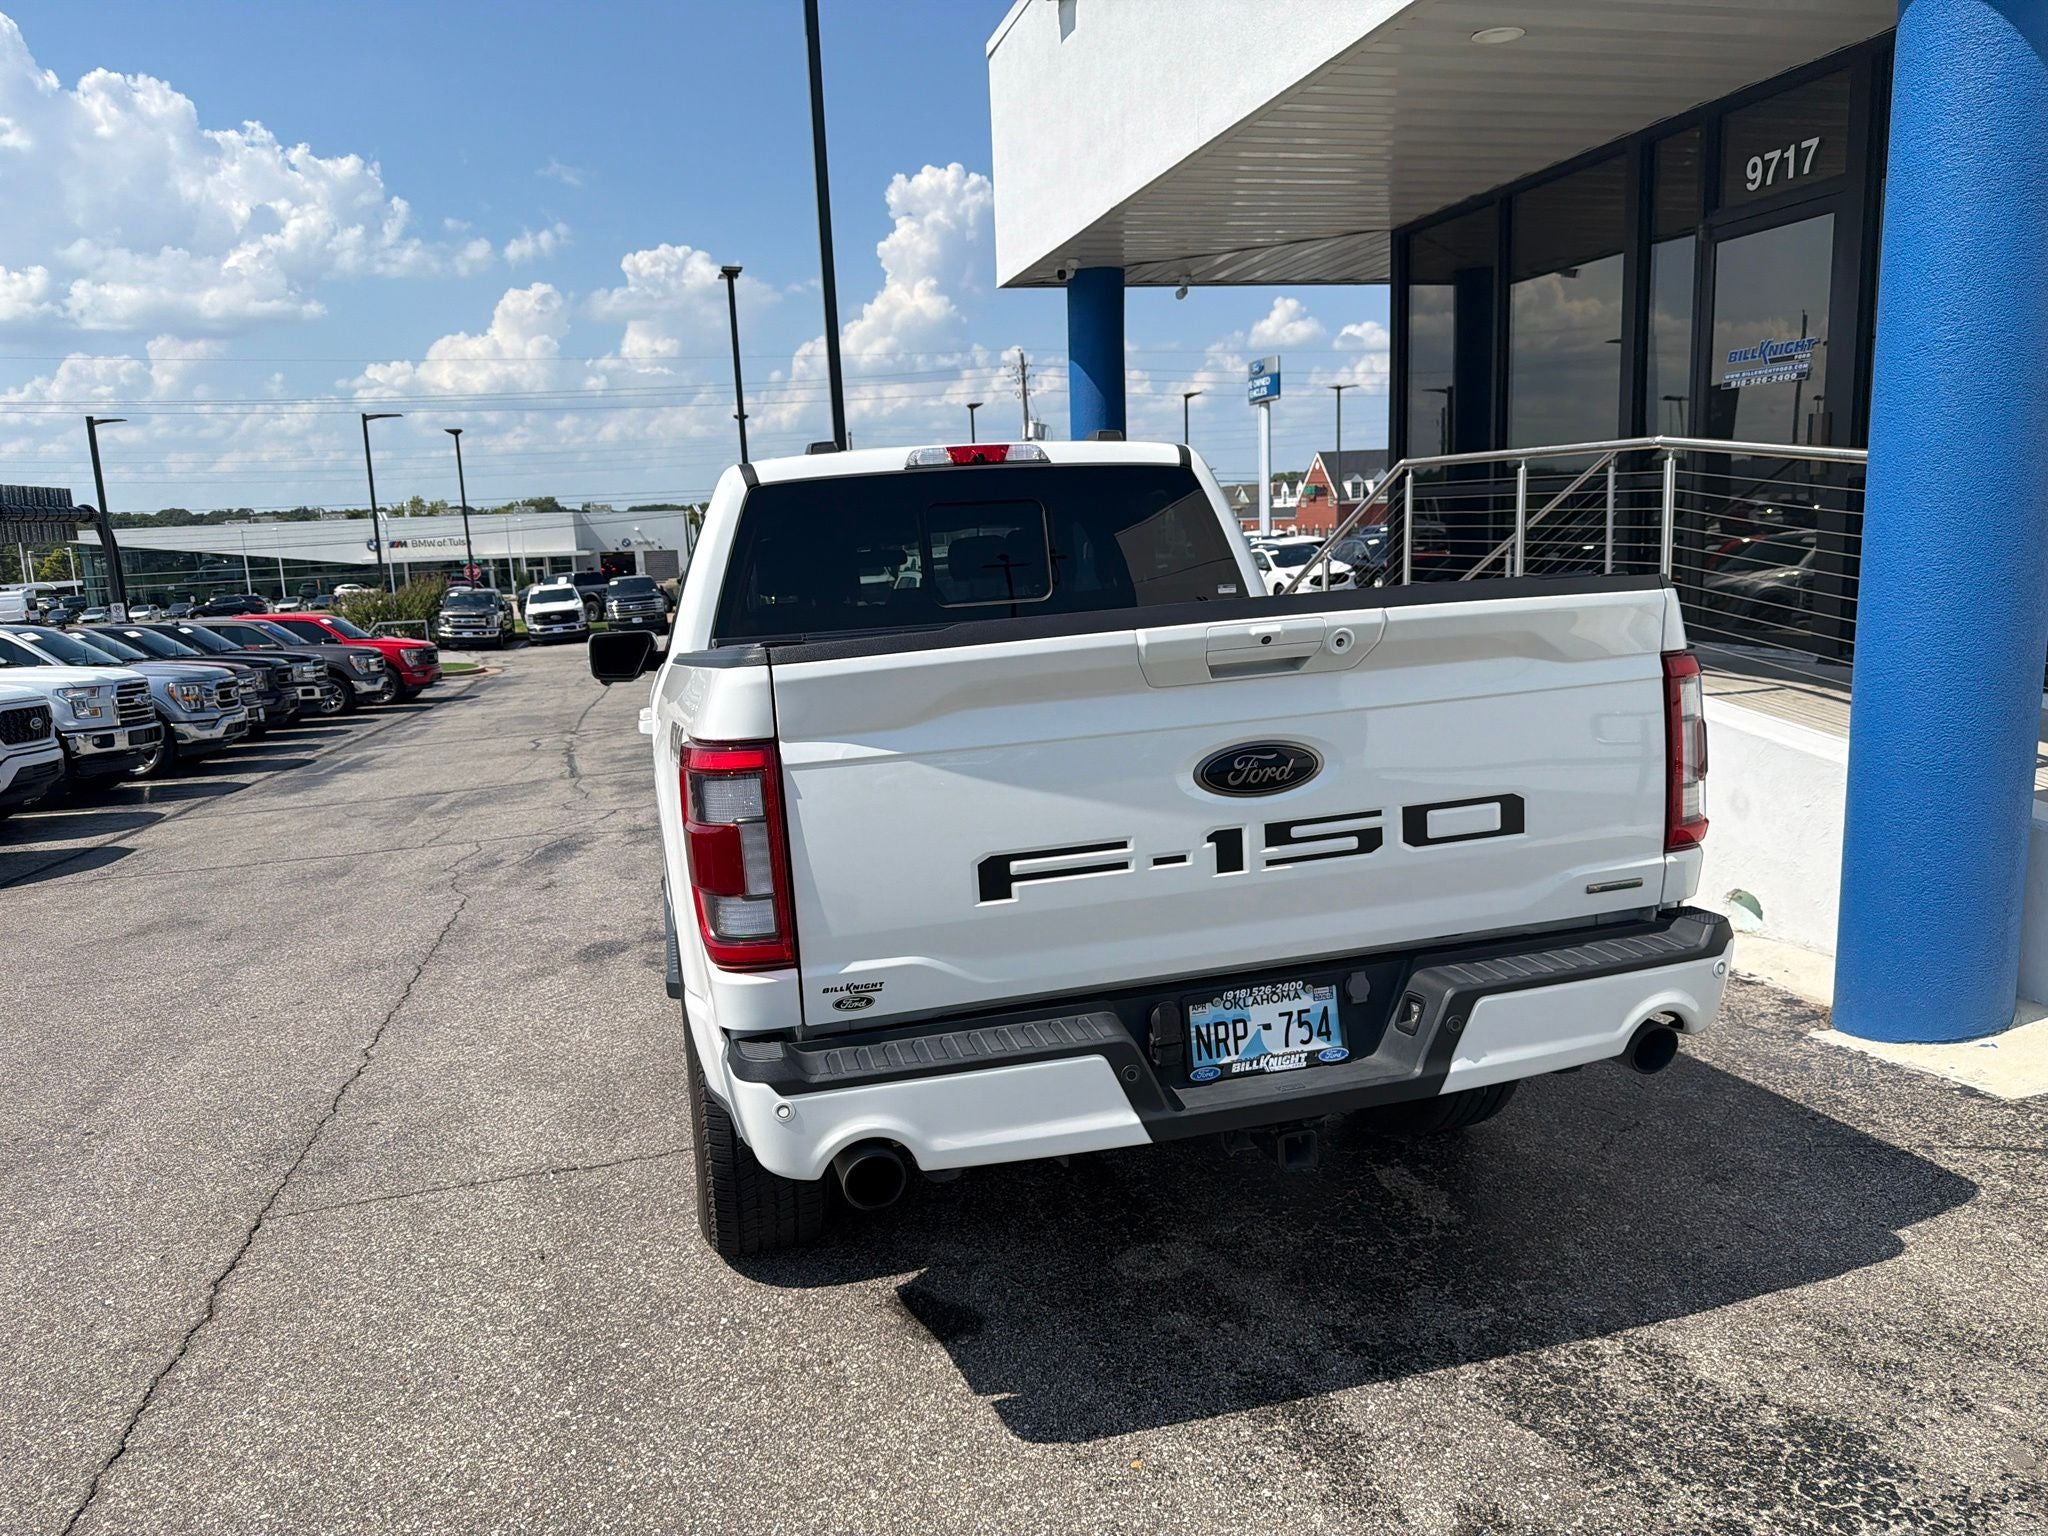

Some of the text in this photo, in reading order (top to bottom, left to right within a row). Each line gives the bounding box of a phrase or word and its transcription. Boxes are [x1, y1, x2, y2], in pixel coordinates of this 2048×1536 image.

[1745, 136, 1820, 192] 9717
[411, 540, 436, 548] BMW
[437, 539, 446, 547] of
[449, 538, 471, 547] Tuls
[1227, 753, 1295, 786] Ford
[977, 792, 1526, 903] F-150
[1222, 987, 1250, 1000] (918)
[1251, 981, 1304, 996] 526-2400
[1222, 990, 1302, 1010] OKLAHOMA
[840, 998, 867, 1009] Ford
[1191, 1002, 1207, 1012] APR
